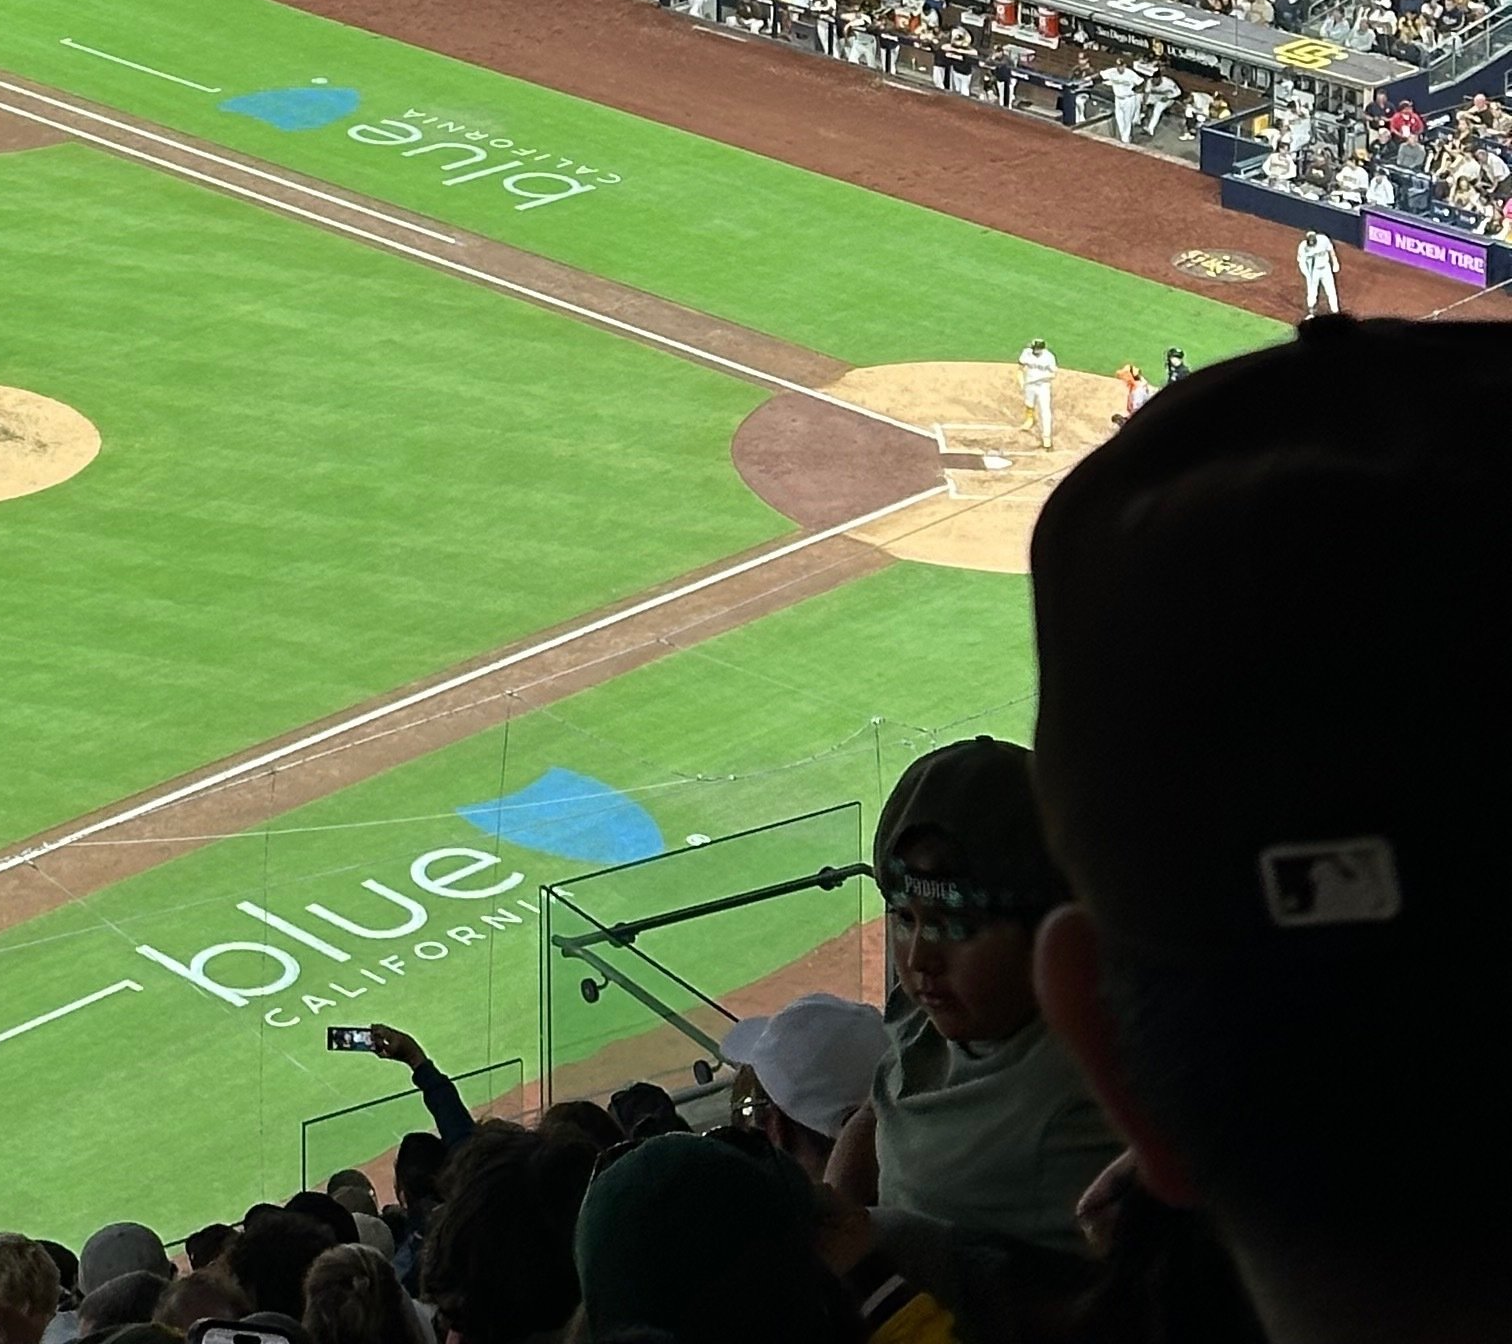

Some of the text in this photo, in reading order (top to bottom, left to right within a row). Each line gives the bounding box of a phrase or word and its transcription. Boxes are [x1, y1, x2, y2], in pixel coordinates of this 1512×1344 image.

[347, 119, 597, 211] blue
[402, 108, 622, 185] CALIFORNIA
[1395, 232, 1485, 273] NEXEN TIRE
[136, 847, 525, 1007] blue
[265, 886, 575, 1029] CALIFORNIA
